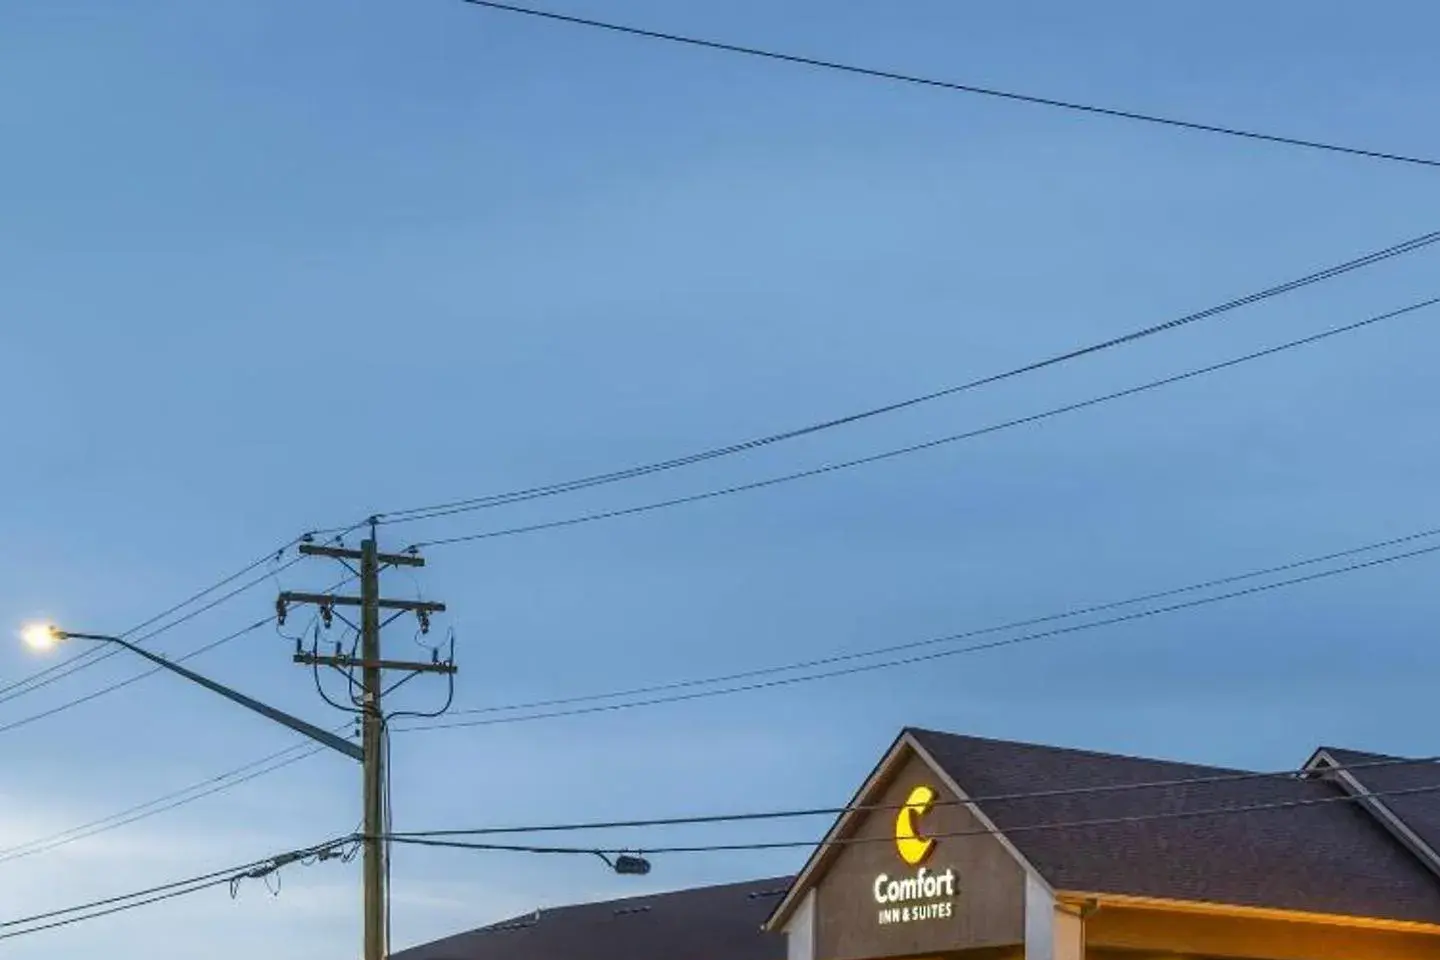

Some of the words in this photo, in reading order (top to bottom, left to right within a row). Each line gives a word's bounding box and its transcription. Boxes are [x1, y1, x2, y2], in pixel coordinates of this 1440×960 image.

[874, 867, 955, 903] Comfort
[879, 908, 900, 924] INN
[902, 907, 911, 922] &
[912, 902, 952, 920] SUITES
